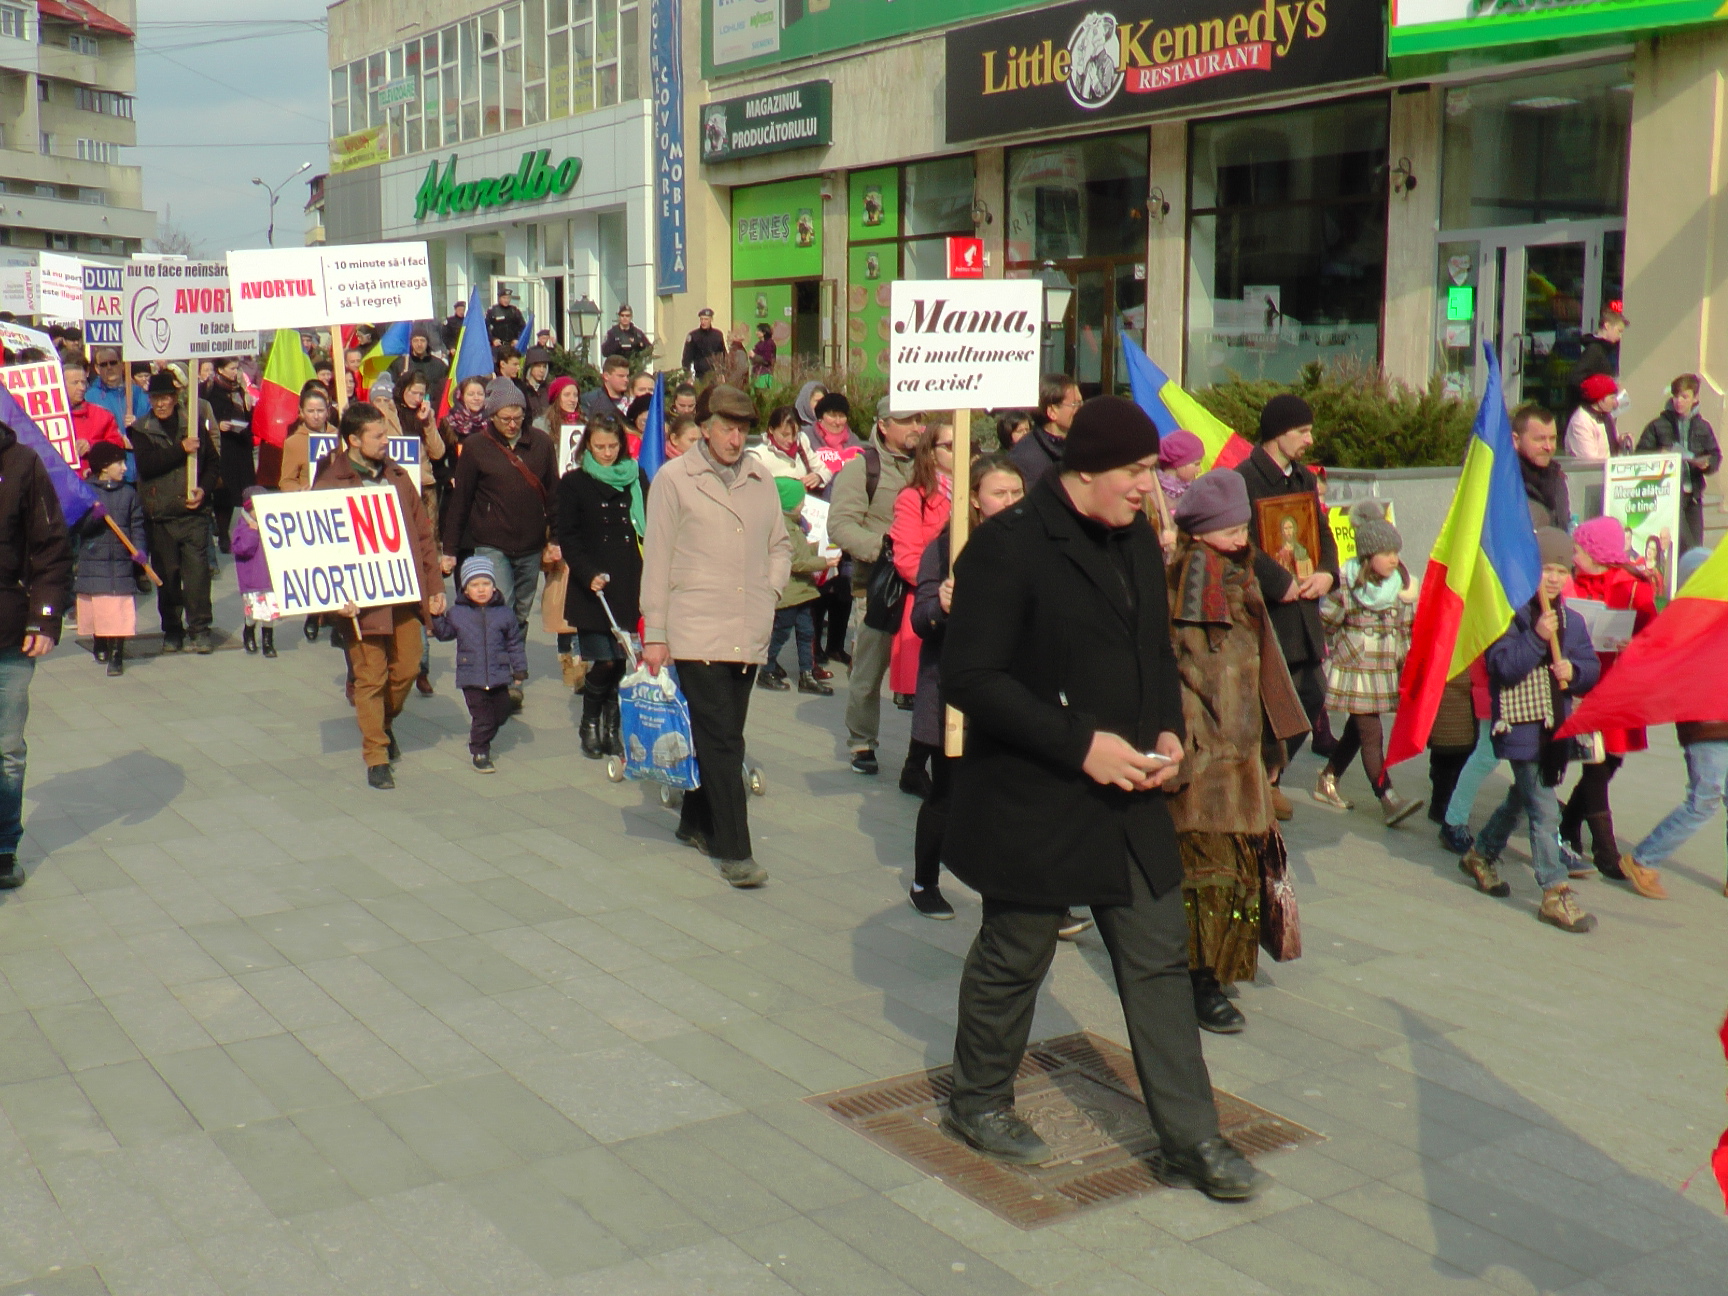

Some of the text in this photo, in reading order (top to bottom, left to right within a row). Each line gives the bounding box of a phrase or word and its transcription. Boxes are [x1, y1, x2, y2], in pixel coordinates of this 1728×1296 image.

[981, 40, 1071, 96] Little
[1138, 43, 1262, 90] RESTAURANT
[745, 90, 803, 119] MAGAZINUL
[661, 66, 670, 217] COVOARE
[731, 116, 818, 150] PRODUCĂTORULUI
[413, 148, 583, 220] Marelbo
[669, 142, 685, 272] MOBILĂ
[127, 265, 142, 277] nu
[144, 264, 155, 277] te
[158, 263, 182, 278] face
[334, 261, 347, 270] 10
[349, 258, 386, 269] minute
[408, 257, 426, 266] faci
[42, 288, 59, 297] este
[240, 278, 316, 300] AVORTUL
[338, 282, 346, 291] o
[379, 277, 428, 291] întreagă
[200, 323, 210, 335] te
[211, 322, 230, 335] face
[894, 298, 1035, 338] Mama,
[190, 338, 257, 353] unui copil mort.
[897, 345, 1035, 364] iti multumesc
[896, 372, 983, 393] ca exist!
[1625, 502, 1637, 513] de
[264, 493, 402, 556] SPUNE NU
[283, 558, 415, 609] AVORTULUI
